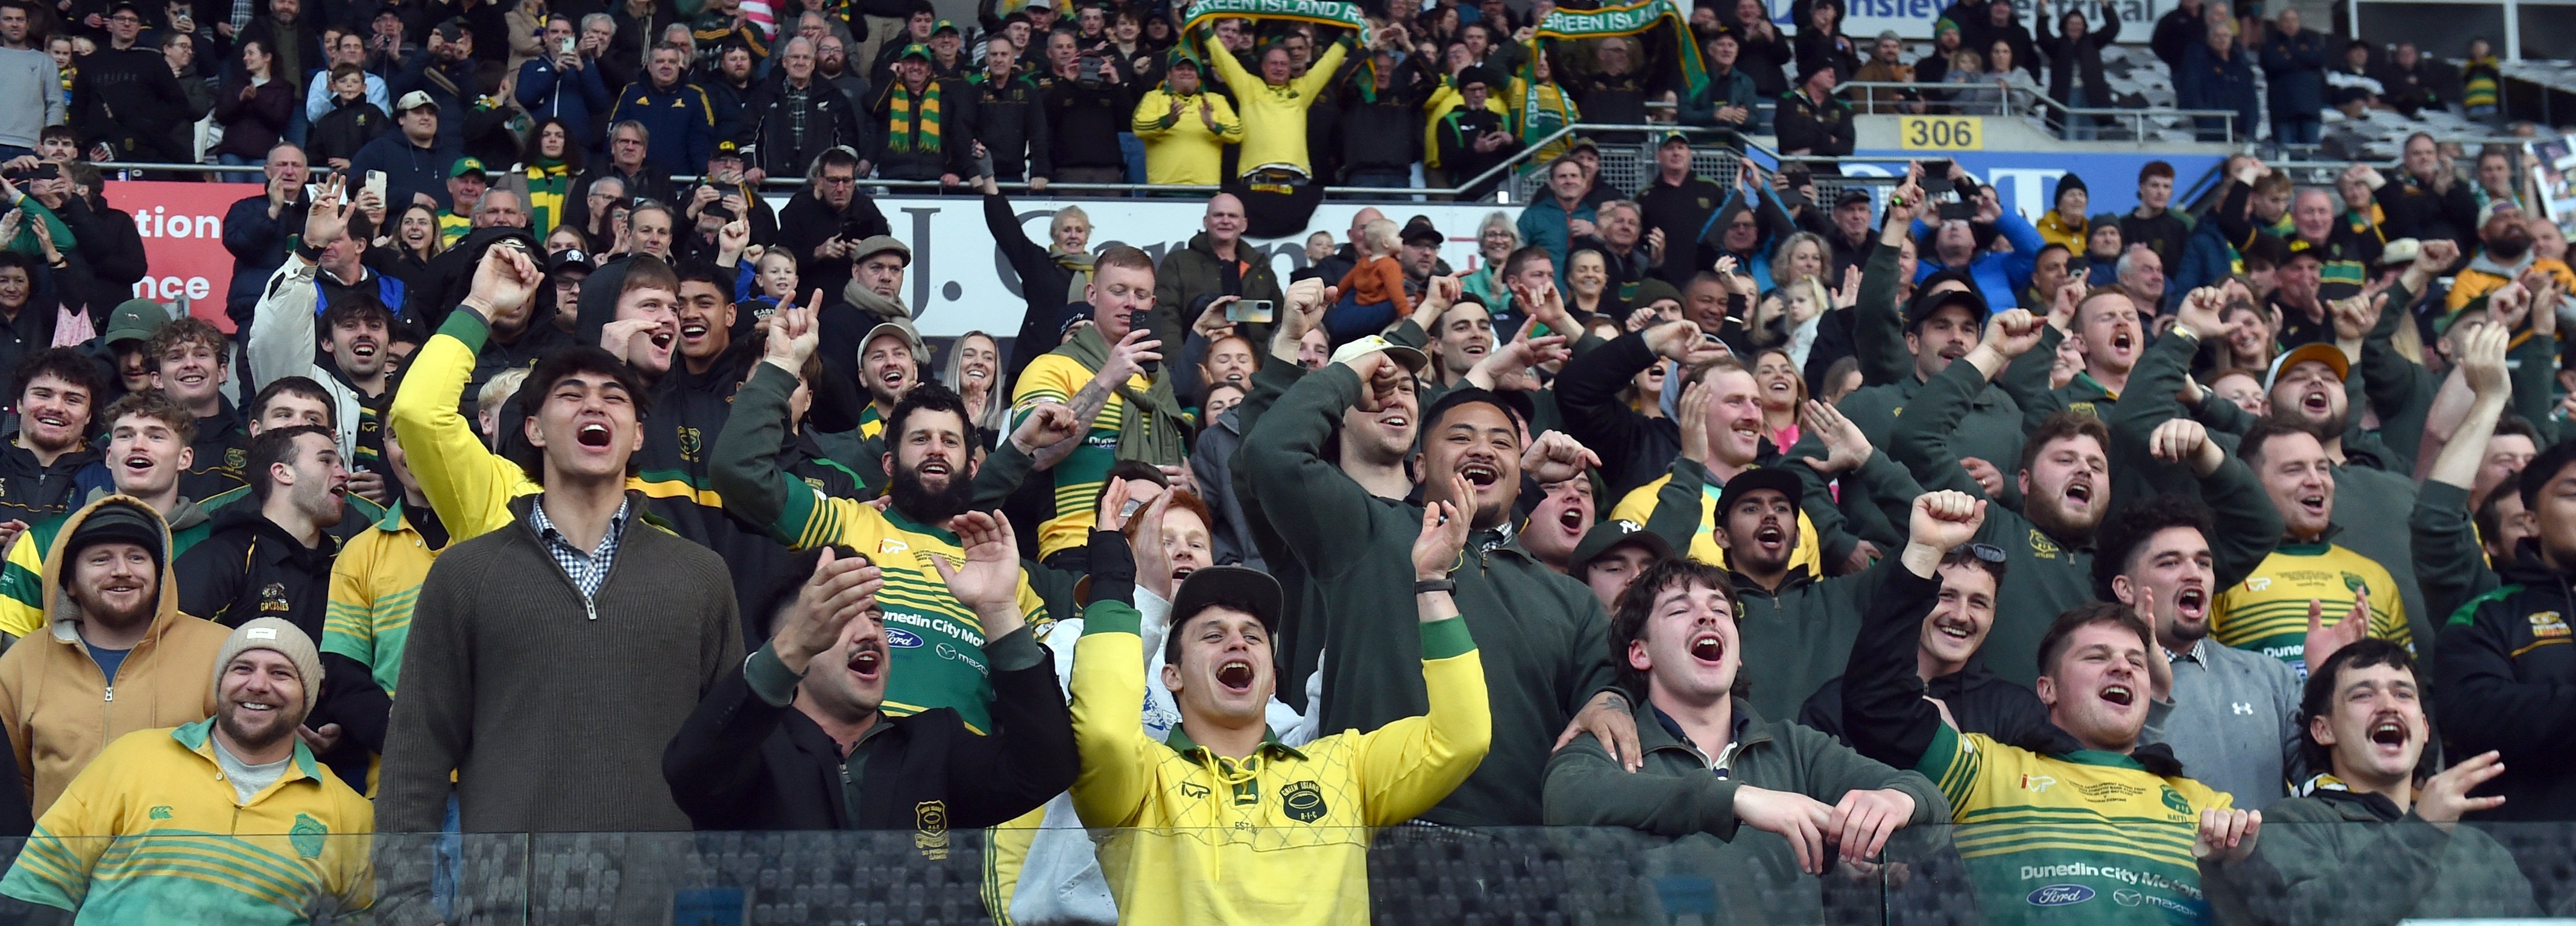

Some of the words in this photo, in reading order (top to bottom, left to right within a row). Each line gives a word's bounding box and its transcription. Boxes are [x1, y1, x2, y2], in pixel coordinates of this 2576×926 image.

[1185, 0, 1259, 19] GREEN
[1261, 0, 1339, 16] ISLAND
[1541, 12, 1604, 31] GREEN
[1911, 120, 1972, 146] 306
[932, 619, 961, 638] City
[2263, 644, 2305, 658] Dune
[1281, 783, 1299, 796] GREEN
[1300, 782, 1319, 792] ISLAND
[2021, 862, 2099, 881] Dunedin
[2101, 866, 2140, 885] City
[2141, 871, 2203, 900] Motors
[2038, 886, 2082, 904] Ford
